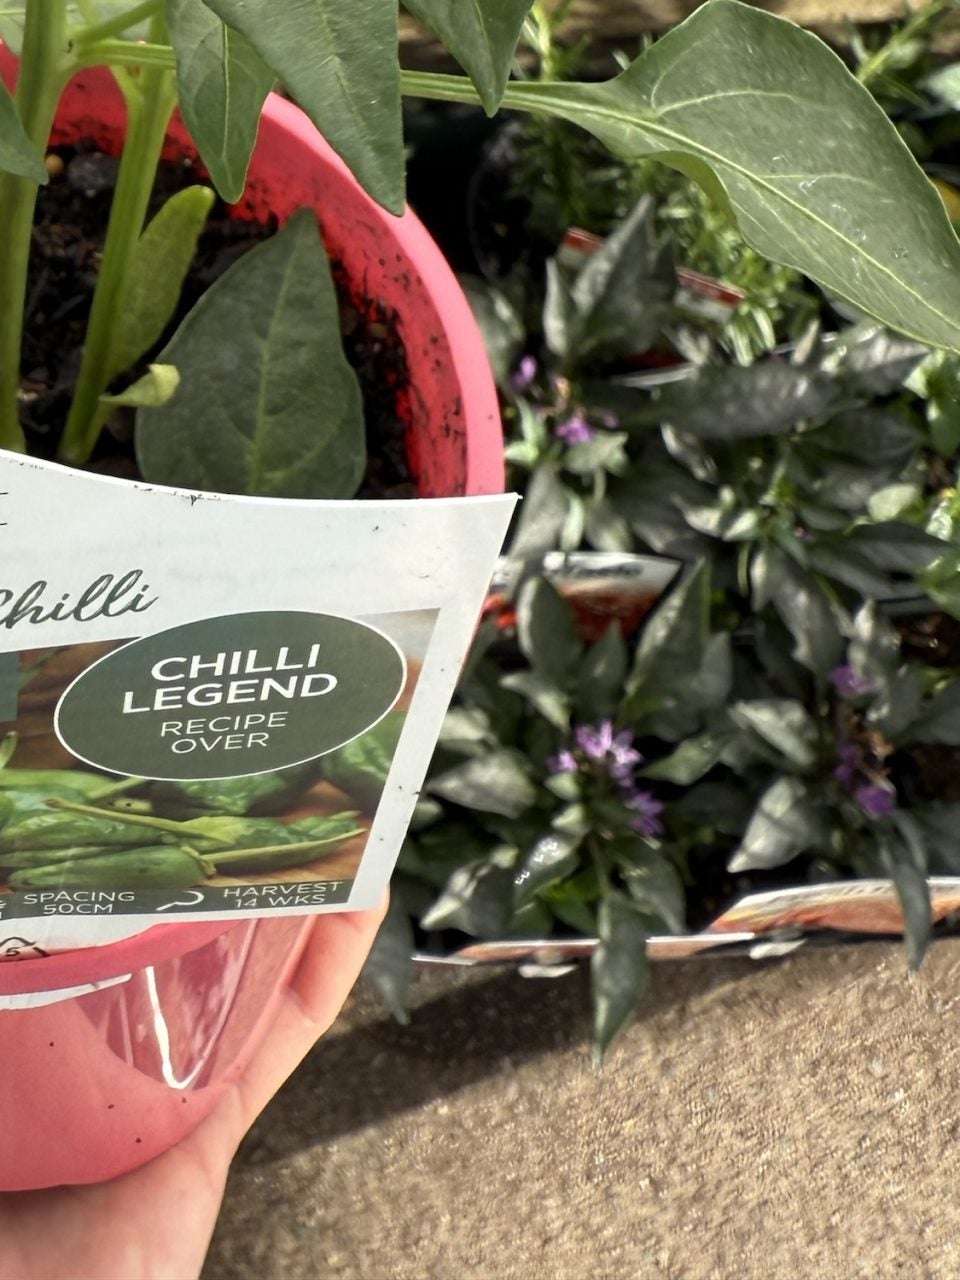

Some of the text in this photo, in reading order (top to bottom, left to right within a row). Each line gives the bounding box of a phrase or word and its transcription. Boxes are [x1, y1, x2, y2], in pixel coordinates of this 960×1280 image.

[151, 644, 321, 682] CHILLI
[123, 673, 338, 714] LEGEND
[160, 711, 287, 737] RECIPE
[172, 731, 269, 754] OVER
[23, 891, 135, 905] SPACING
[224, 881, 344, 898] HARVEST
[43, 903, 113, 915] 50CM
[235, 894, 326, 909] 14 WKS
